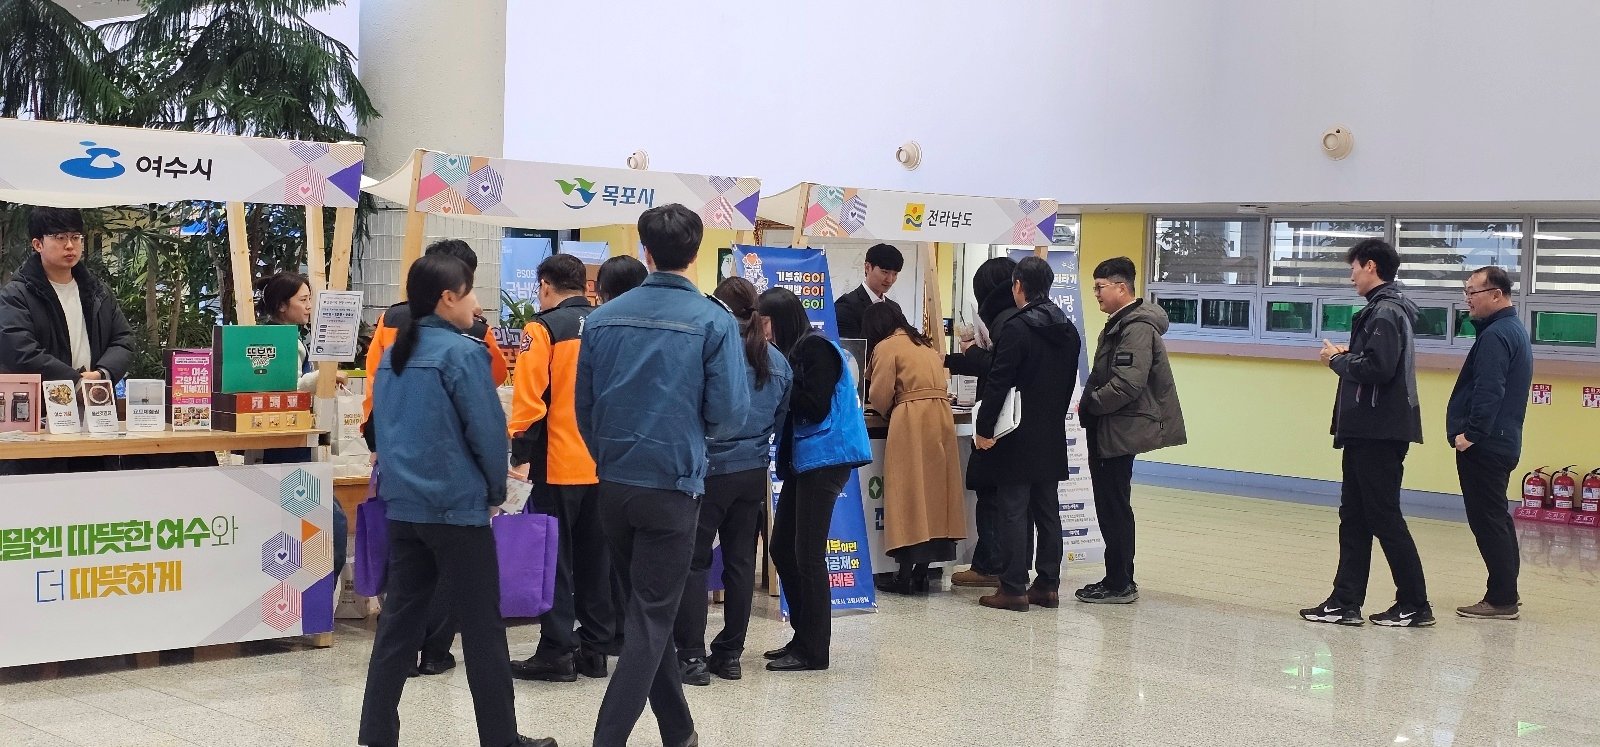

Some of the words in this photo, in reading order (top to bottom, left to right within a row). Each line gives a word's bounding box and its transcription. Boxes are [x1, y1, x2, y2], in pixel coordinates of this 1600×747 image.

[136, 155, 213, 181] 여수시
[602, 185, 655, 208] 목포시
[927, 210, 973, 228] 전라남도
[776, 271, 825, 283] 기부하GO!
[1049, 295, 1075, 313] 사랑
[0, 525, 63, 562] 말엔
[67, 519, 154, 557] 따뜻한
[156, 515, 239, 551] 여수와
[36, 569, 65, 603] 더
[69, 560, 182, 601] 따뜻하게
